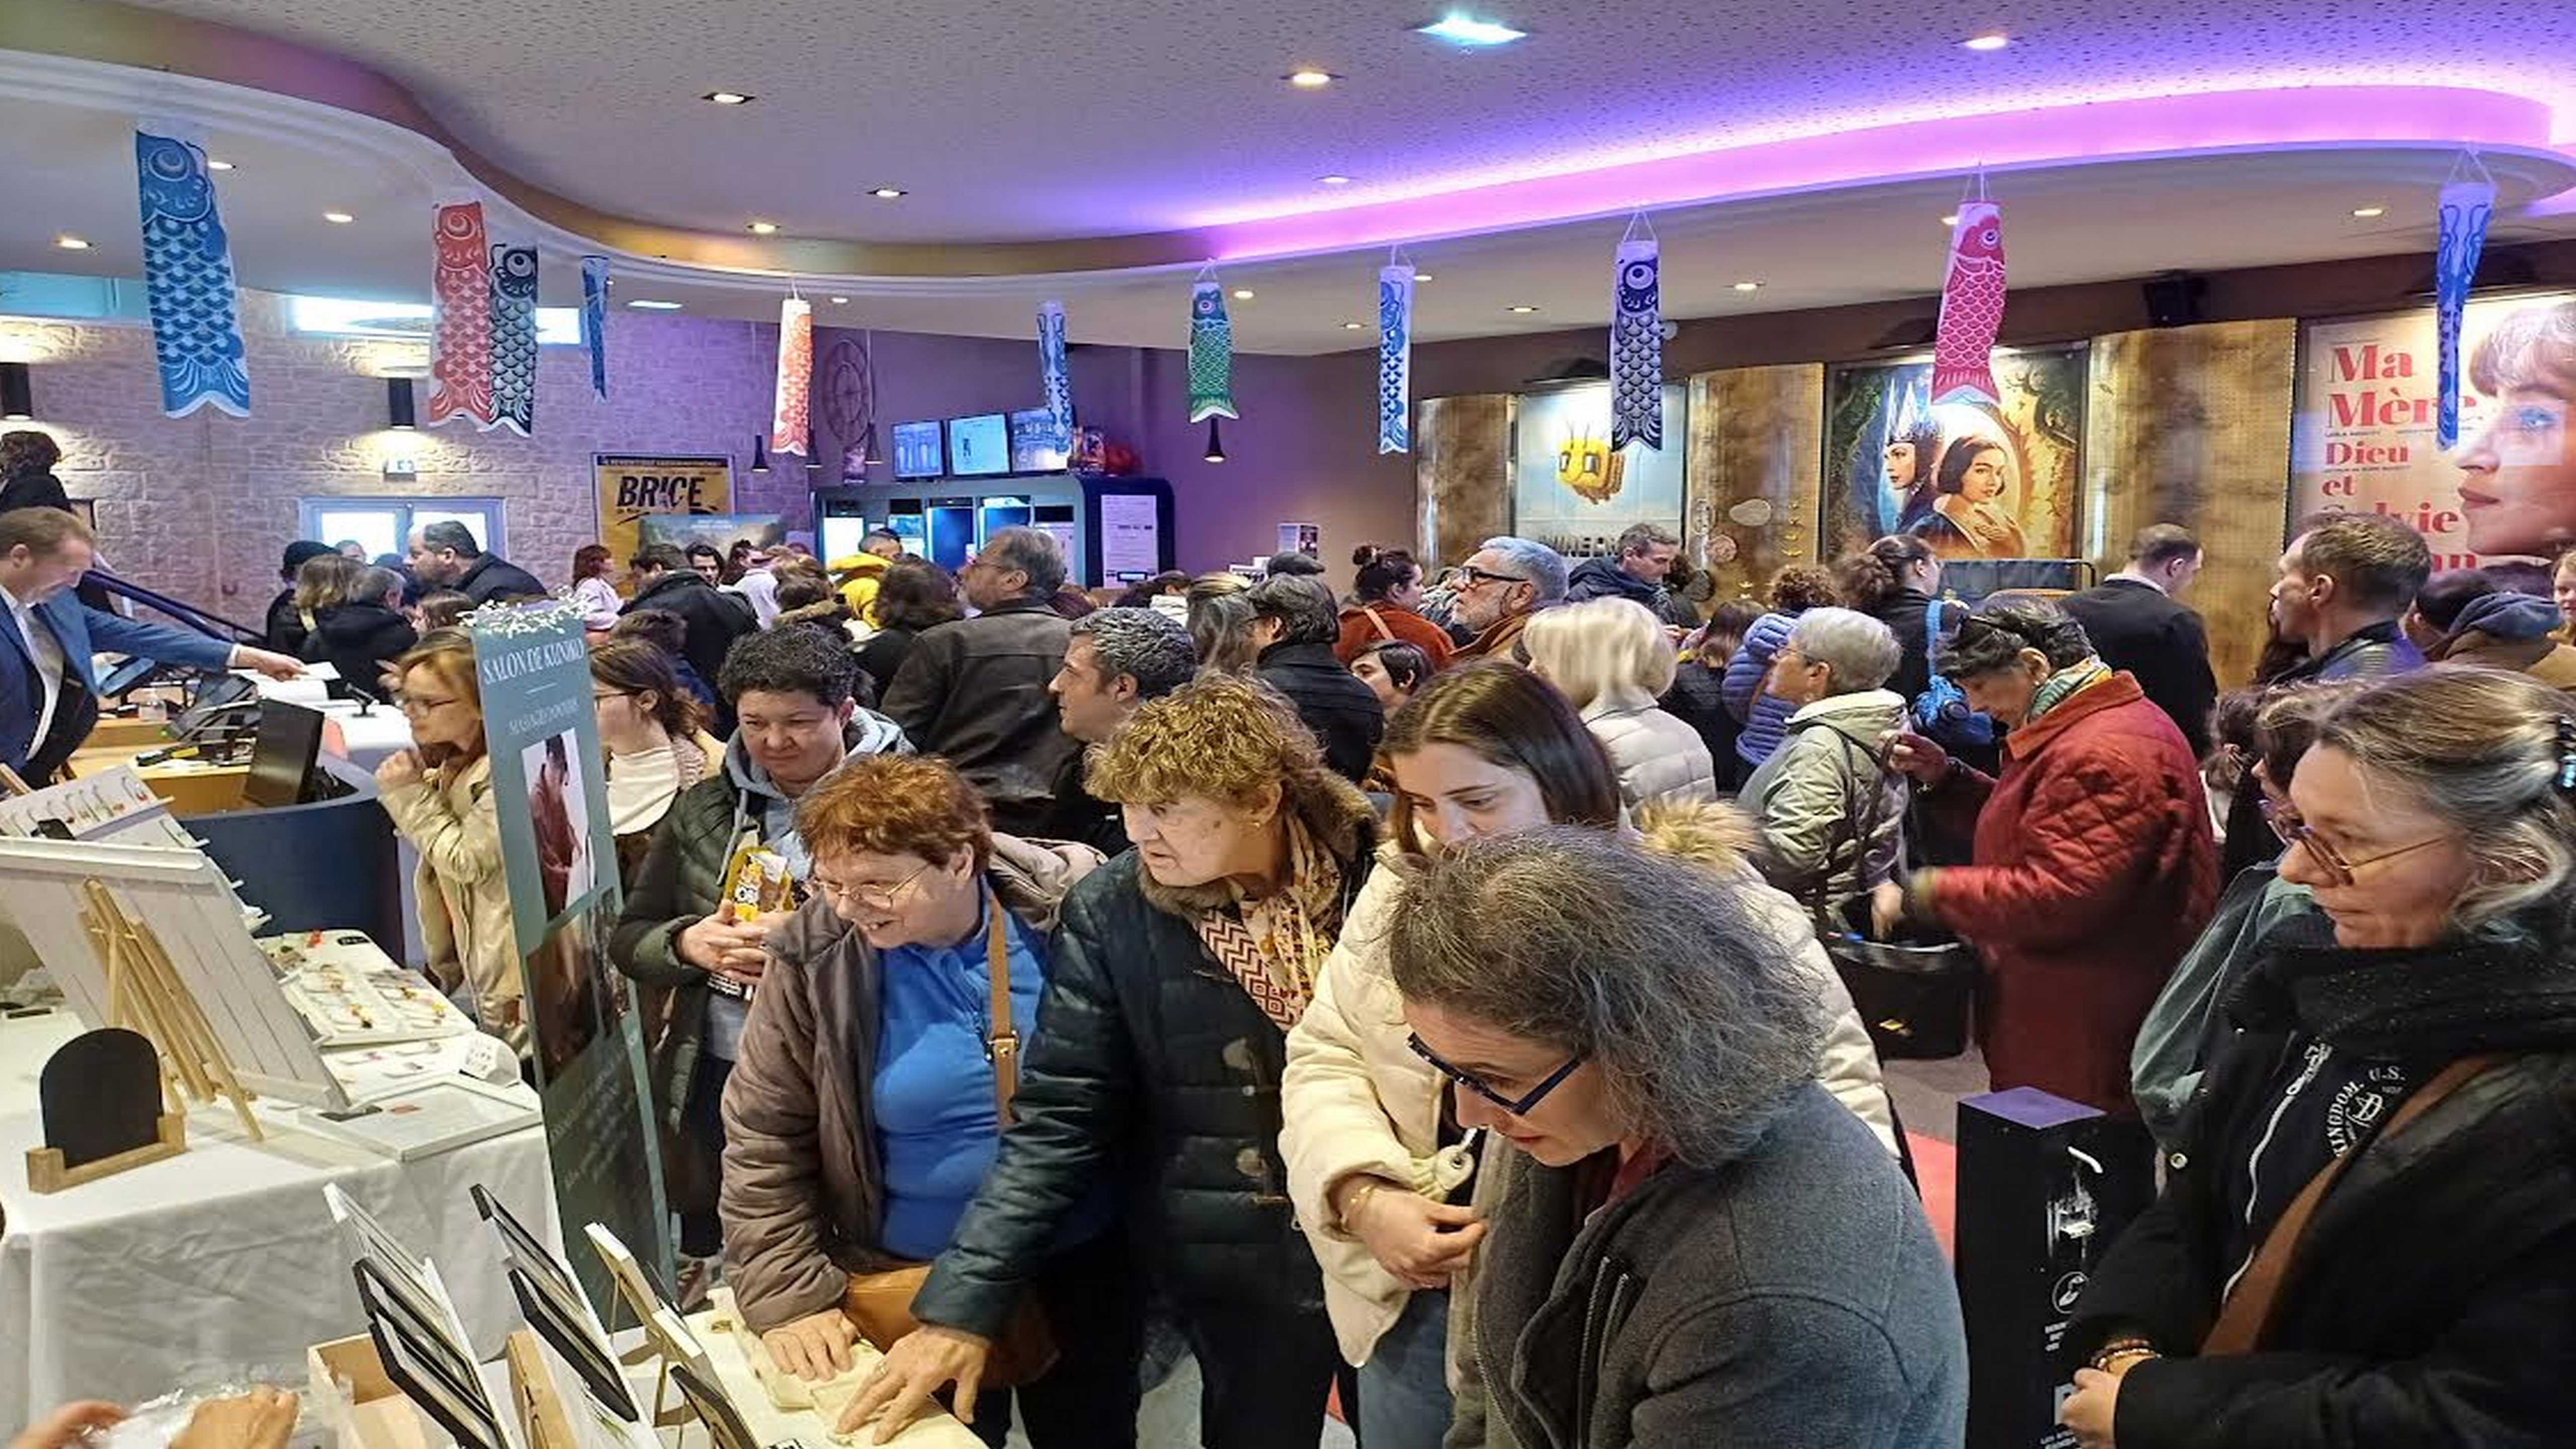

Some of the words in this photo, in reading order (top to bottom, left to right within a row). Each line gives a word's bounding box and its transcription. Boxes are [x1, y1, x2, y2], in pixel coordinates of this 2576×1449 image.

[2329, 345, 2414, 383] Ma
[2325, 441, 2408, 465] Dieu
[616, 475, 706, 507] BRICE
[2322, 476, 2356, 496] et
